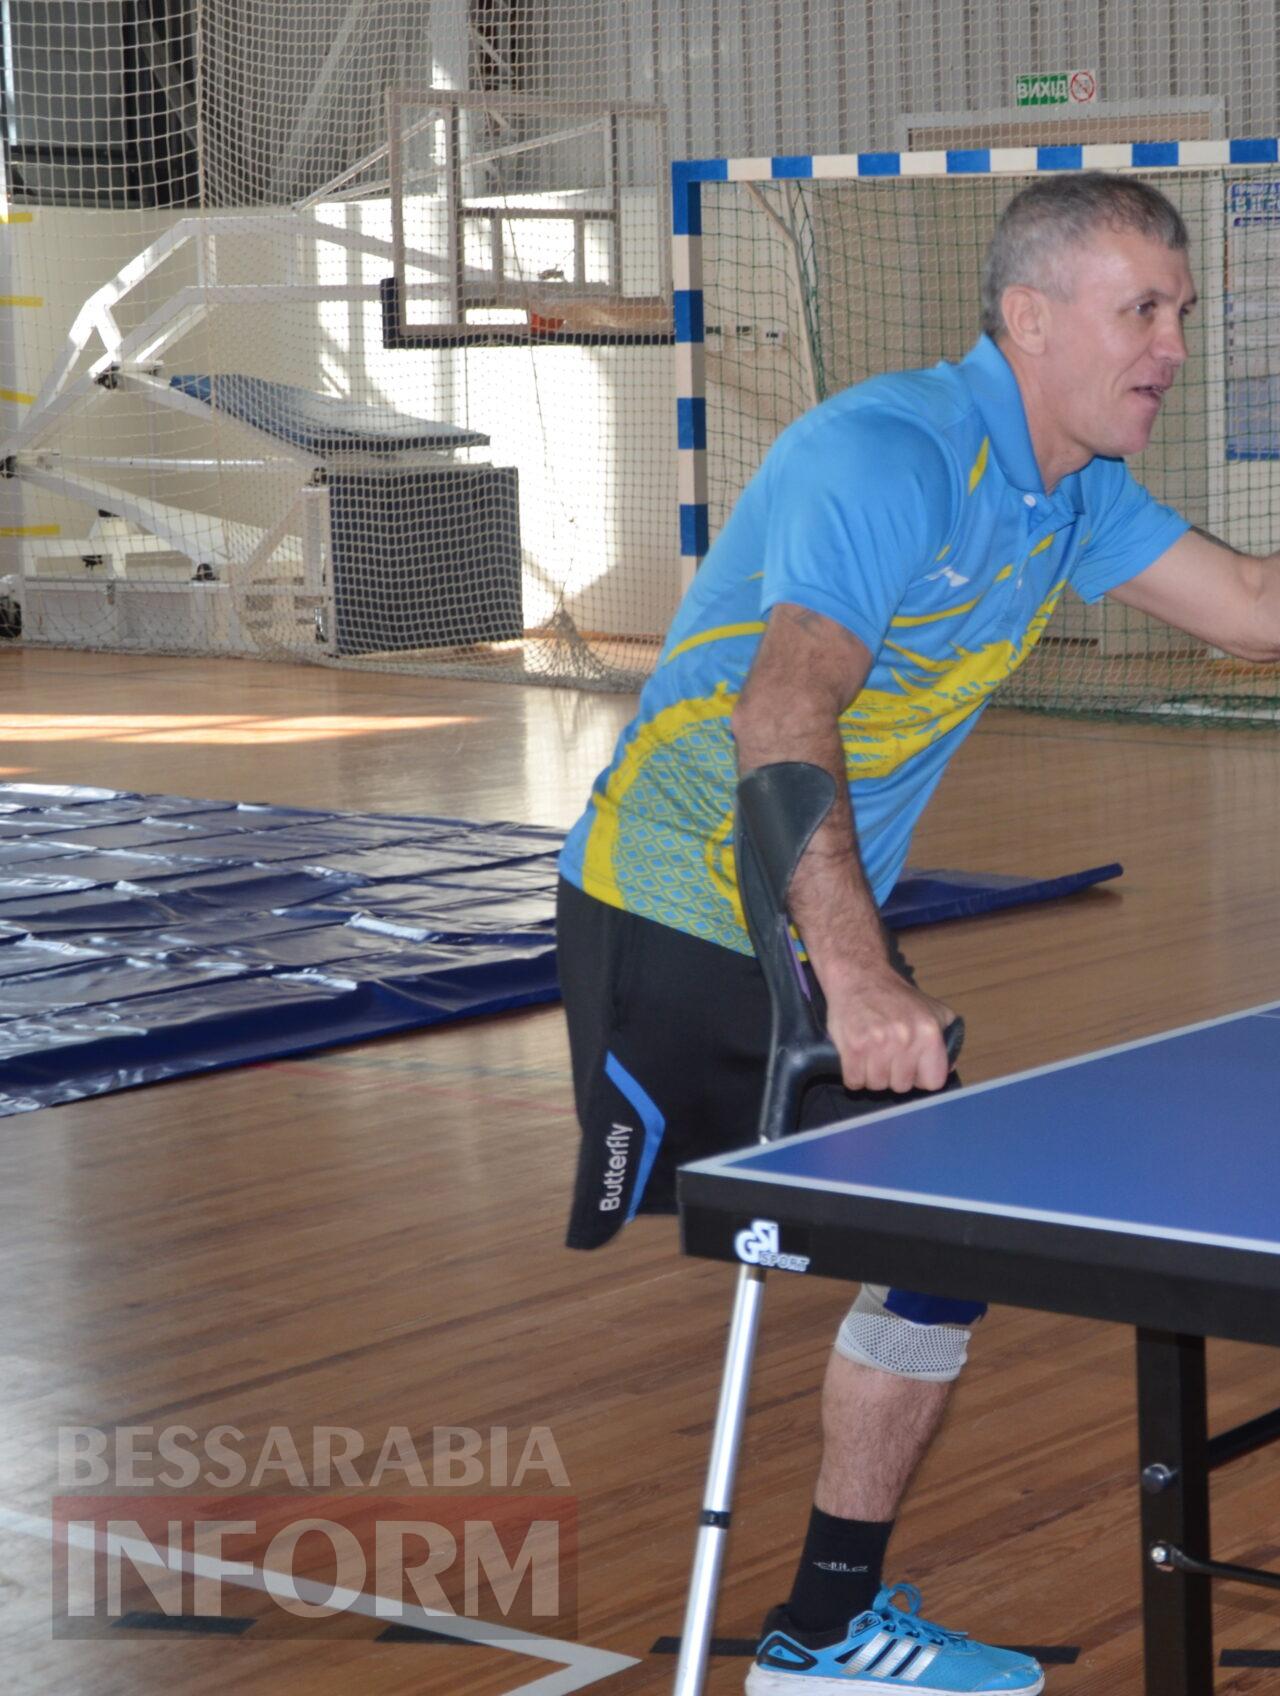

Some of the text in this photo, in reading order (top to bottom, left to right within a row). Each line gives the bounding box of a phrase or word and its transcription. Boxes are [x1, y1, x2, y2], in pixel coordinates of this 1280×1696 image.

[1017, 80, 1067, 99] ВИХІД
[599, 1123, 633, 1211] Butterfly
[759, 1251, 810, 1272] SPORT
